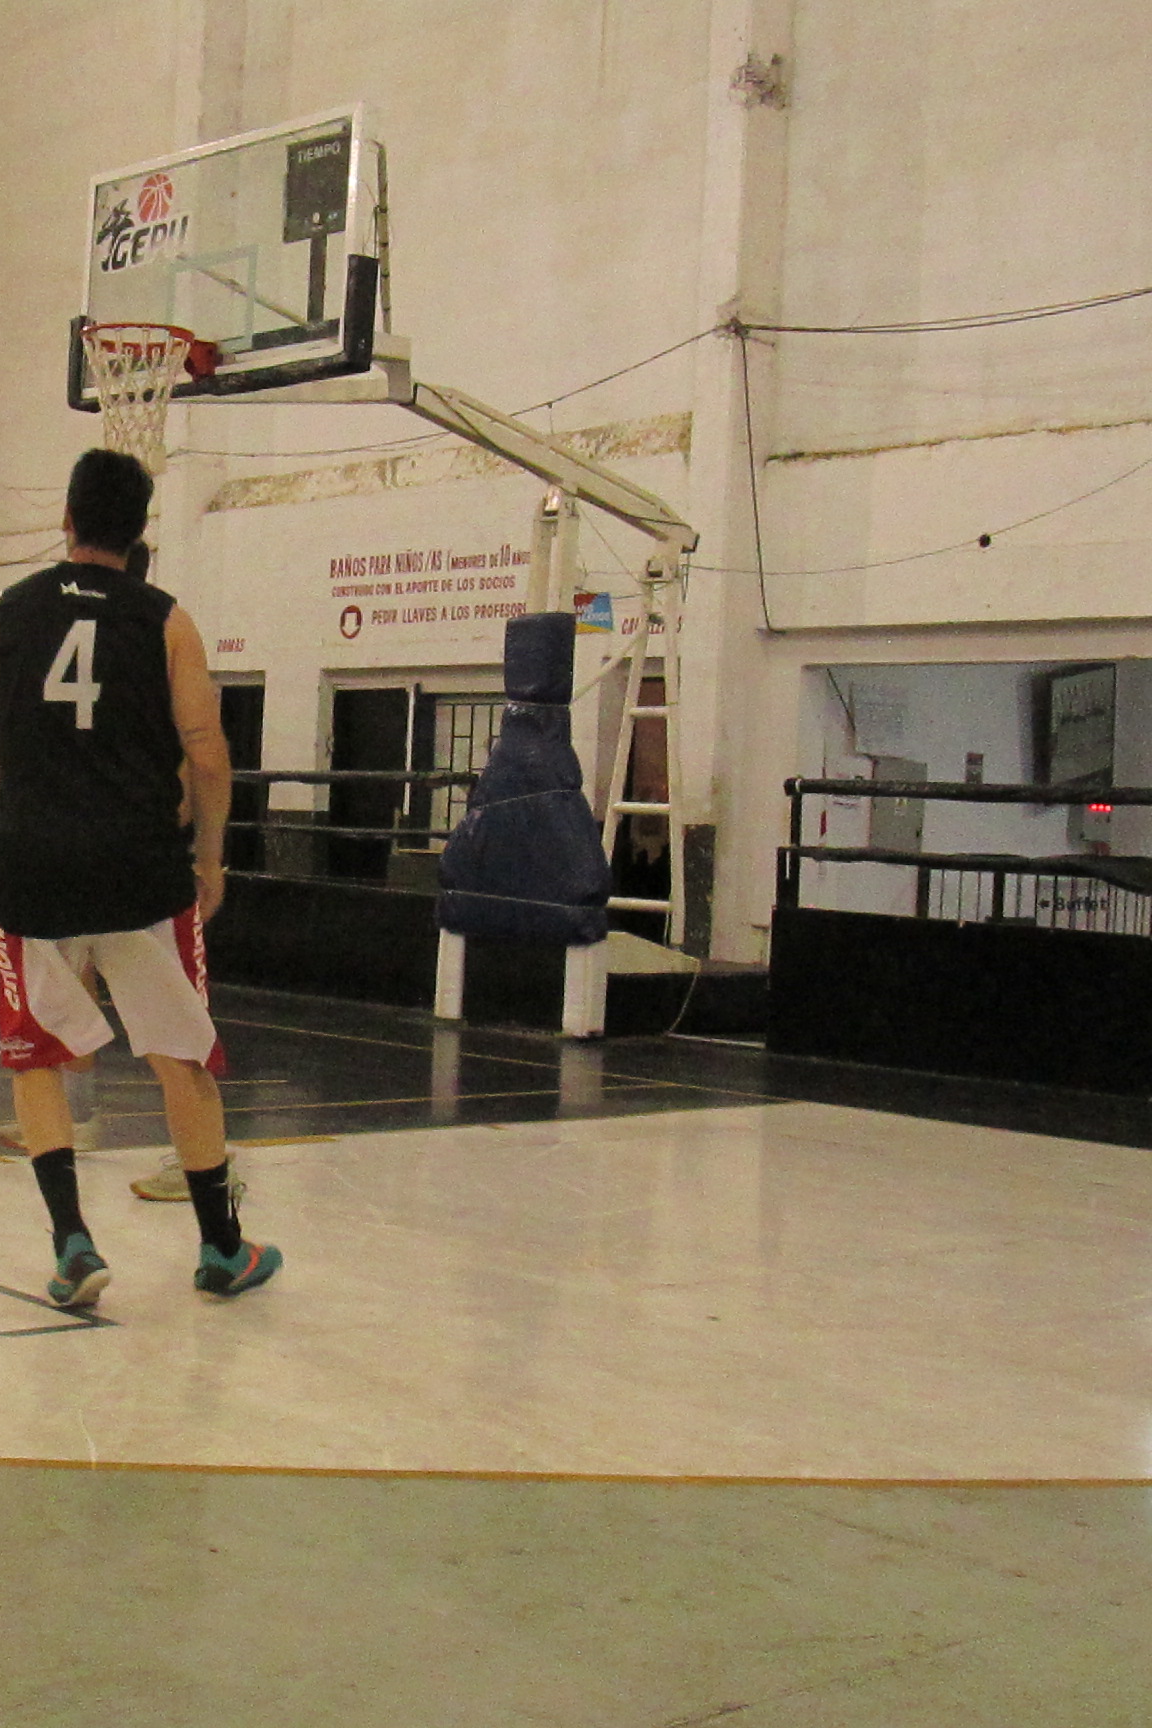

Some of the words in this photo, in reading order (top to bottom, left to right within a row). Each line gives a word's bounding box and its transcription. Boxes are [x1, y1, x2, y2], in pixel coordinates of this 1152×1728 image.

[298, 141, 341, 163] TIEMPO
[330, 553, 367, 579] BAÑOS
[369, 554, 391, 576] PARA
[376, 583, 392, 595] CON
[395, 582, 403, 595] EL
[405, 579, 440, 594] APORTE
[441, 579, 453, 592] DE
[457, 577, 475, 592] LOS
[479, 574, 516, 591] SOCIOS
[371, 608, 398, 625] PEDIR
[402, 606, 438, 624] LLAVES
[440, 605, 448, 621] A
[451, 604, 470, 621] LOS
[44, 619, 102, 730] 4
